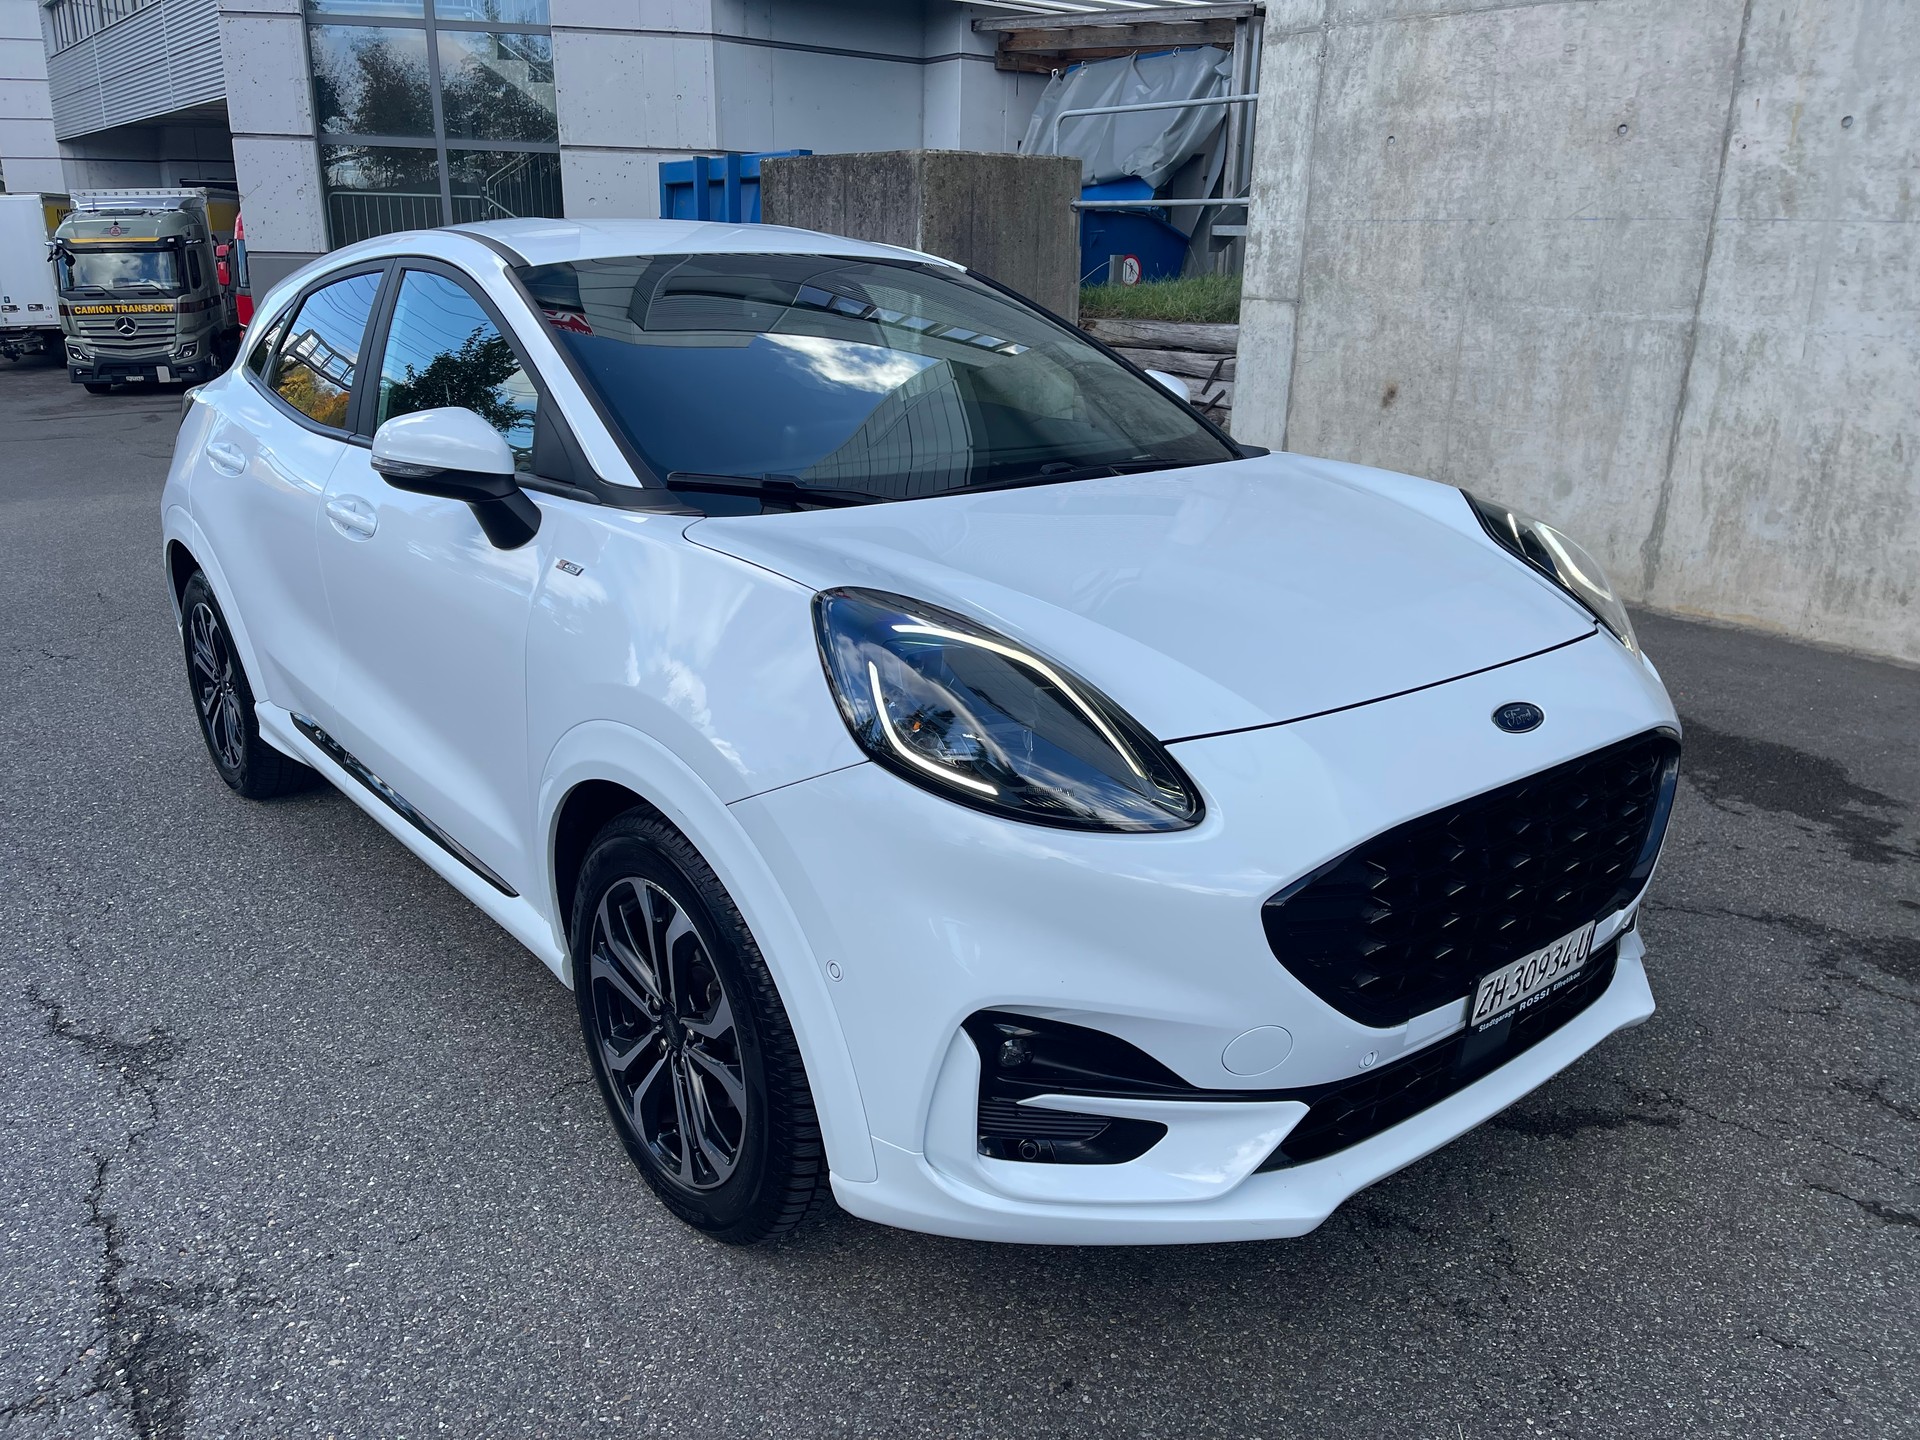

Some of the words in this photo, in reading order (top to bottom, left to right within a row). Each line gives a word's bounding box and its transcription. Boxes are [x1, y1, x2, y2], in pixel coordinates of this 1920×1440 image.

[74, 305, 114, 315] CAMION
[115, 303, 175, 313] TRANSPORT
[1503, 707, 1534, 728] Ford
[1478, 1008, 1516, 1033] Stadtgarage
[1519, 988, 1550, 1012] ROSSI
[1552, 971, 1581, 992] Effretikon
